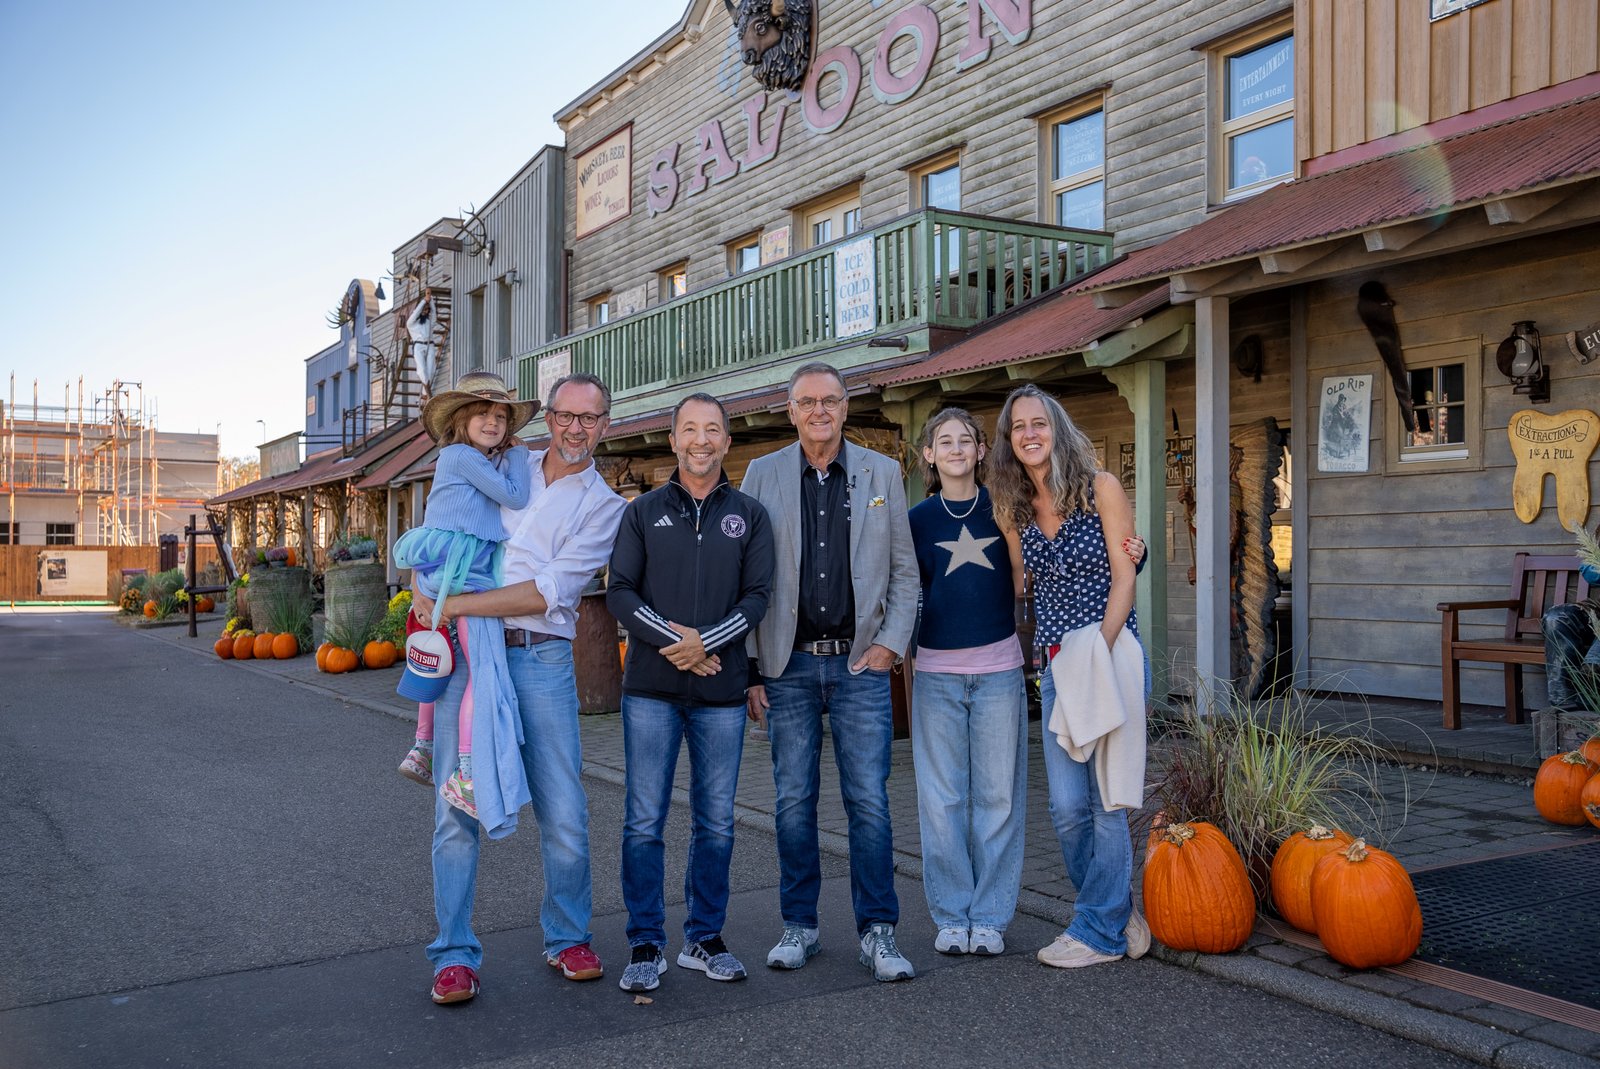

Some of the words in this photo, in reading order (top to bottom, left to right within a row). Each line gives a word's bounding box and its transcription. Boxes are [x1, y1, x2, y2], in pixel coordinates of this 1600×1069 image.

[1239, 45, 1290, 93] ENTERTAINMENT
[1243, 94, 1263, 107] EVERY
[1265, 84, 1287, 99] NIGHT
[646, 0, 1034, 219] SALOON
[579, 150, 606, 188] WHISKEY
[609, 145, 625, 160] BEER
[584, 191, 602, 214] WINES
[845, 253, 864, 272] ICE
[840, 278, 870, 299] COLD
[841, 304, 870, 324] BEER
[1326, 382, 1345, 396] OLD
[1347, 378, 1365, 392] RIP
[1519, 424, 1578, 441] EXTRACTIONS
[1170, 440, 1193, 451] LMP
[1541, 449, 1550, 459] A
[1553, 448, 1575, 460] PULL
[409, 647, 438, 666] STETSON
